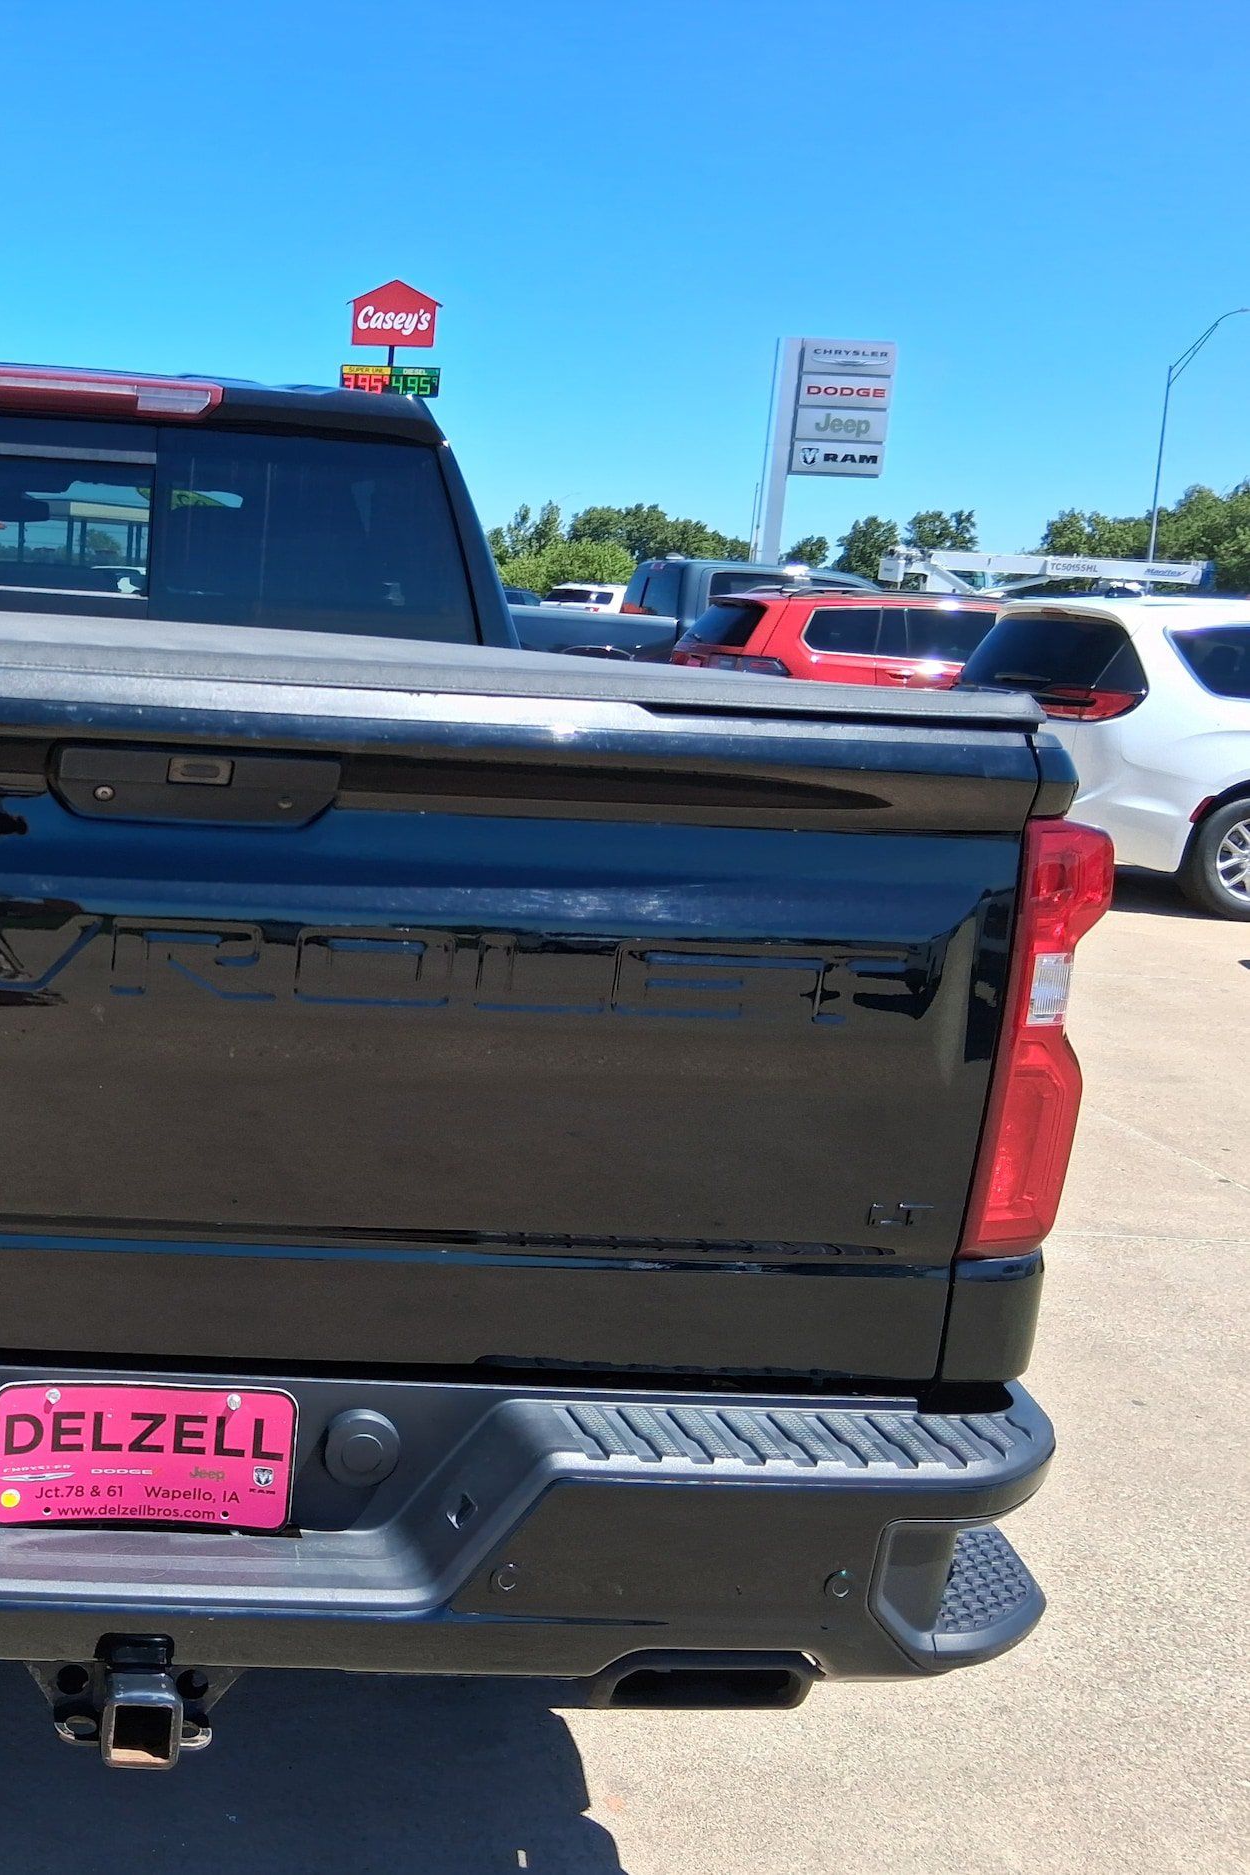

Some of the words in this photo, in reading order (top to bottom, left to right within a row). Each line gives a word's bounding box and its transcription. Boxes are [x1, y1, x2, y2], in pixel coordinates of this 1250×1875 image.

[356, 305, 432, 336] Casey's
[813, 348, 889, 358] CHRYSLER
[806, 385, 887, 398] DODGE
[814, 413, 871, 437] Jeep
[823, 453, 879, 465] RAM
[3, 1411, 284, 1461] DELZELL
[90, 1486, 101, 1498] &
[106, 1485, 123, 1497] 61
[144, 1486, 216, 1503] Wapello,
[222, 1490, 240, 1504] IA
[57, 1503, 216, 1520] www.delzellbros.com
